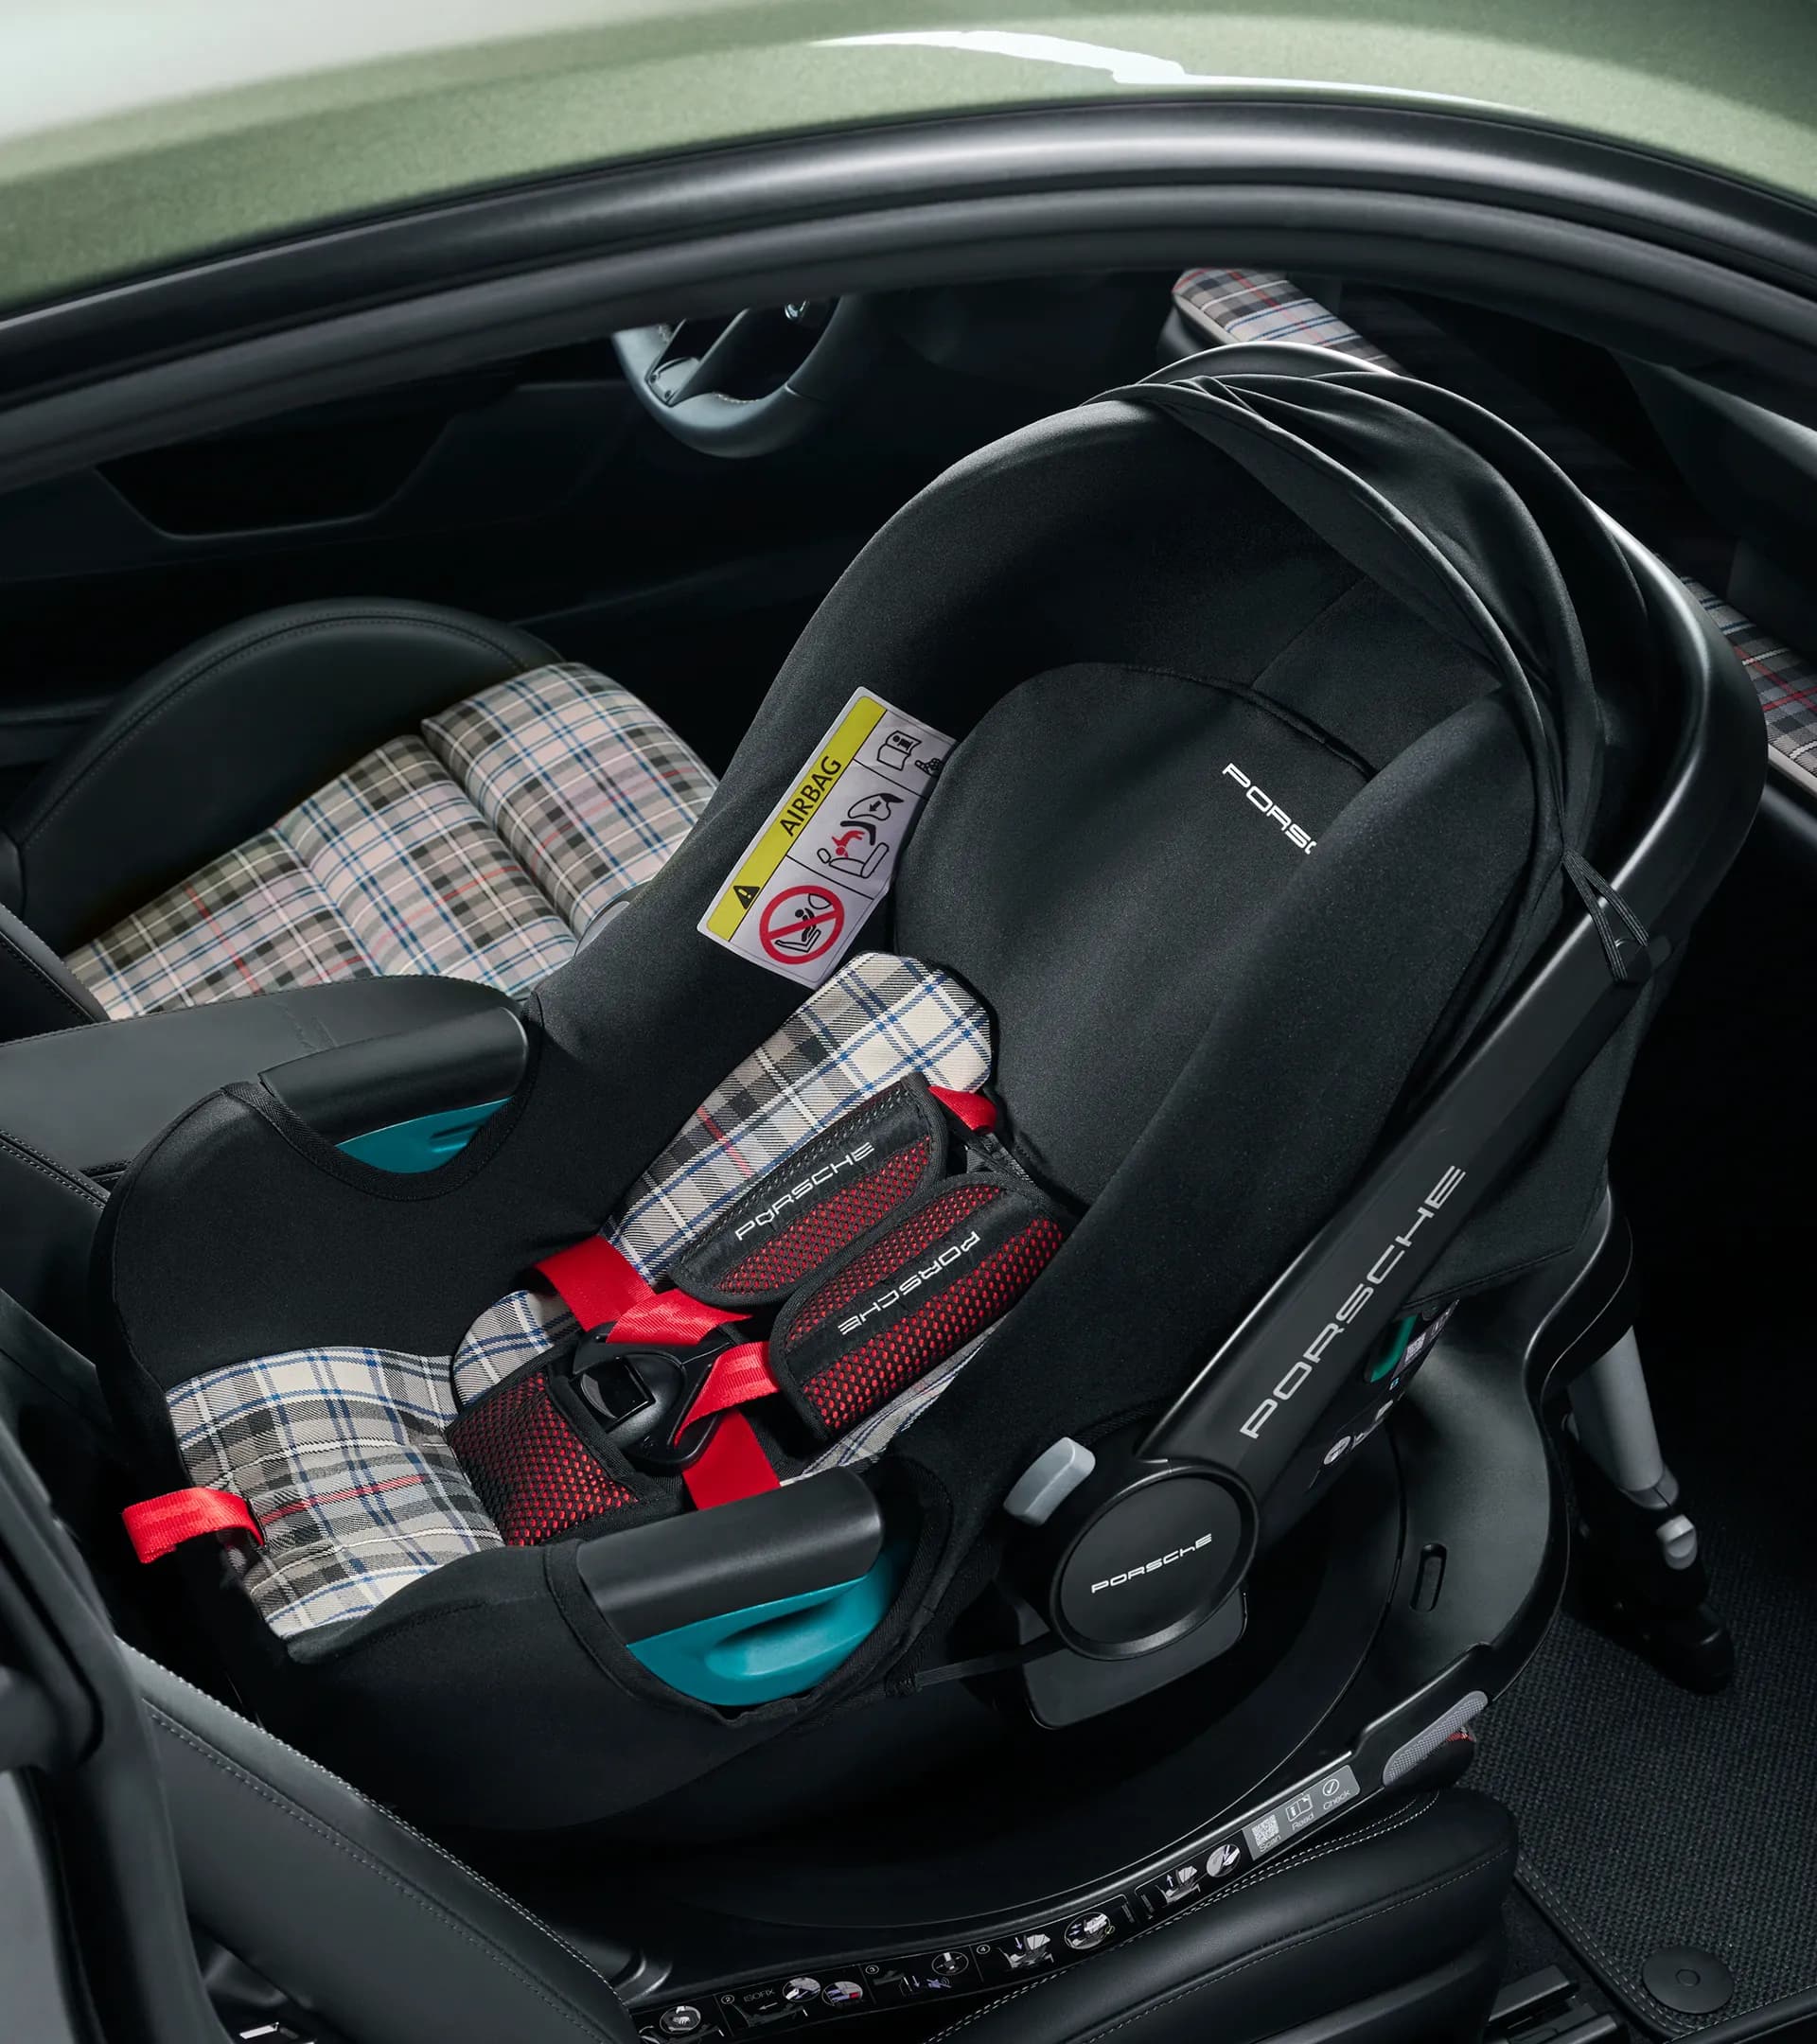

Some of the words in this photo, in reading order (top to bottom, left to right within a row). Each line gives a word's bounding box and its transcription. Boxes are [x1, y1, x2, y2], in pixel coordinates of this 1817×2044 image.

[779, 756, 841, 837] AIRBAG
[734, 1141, 875, 1242] PORSCHE
[838, 1230, 981, 1336] PORSCHE
[1239, 1165, 1466, 1439] PORSCHE
[1090, 1533, 1212, 1594] PORSCHE
